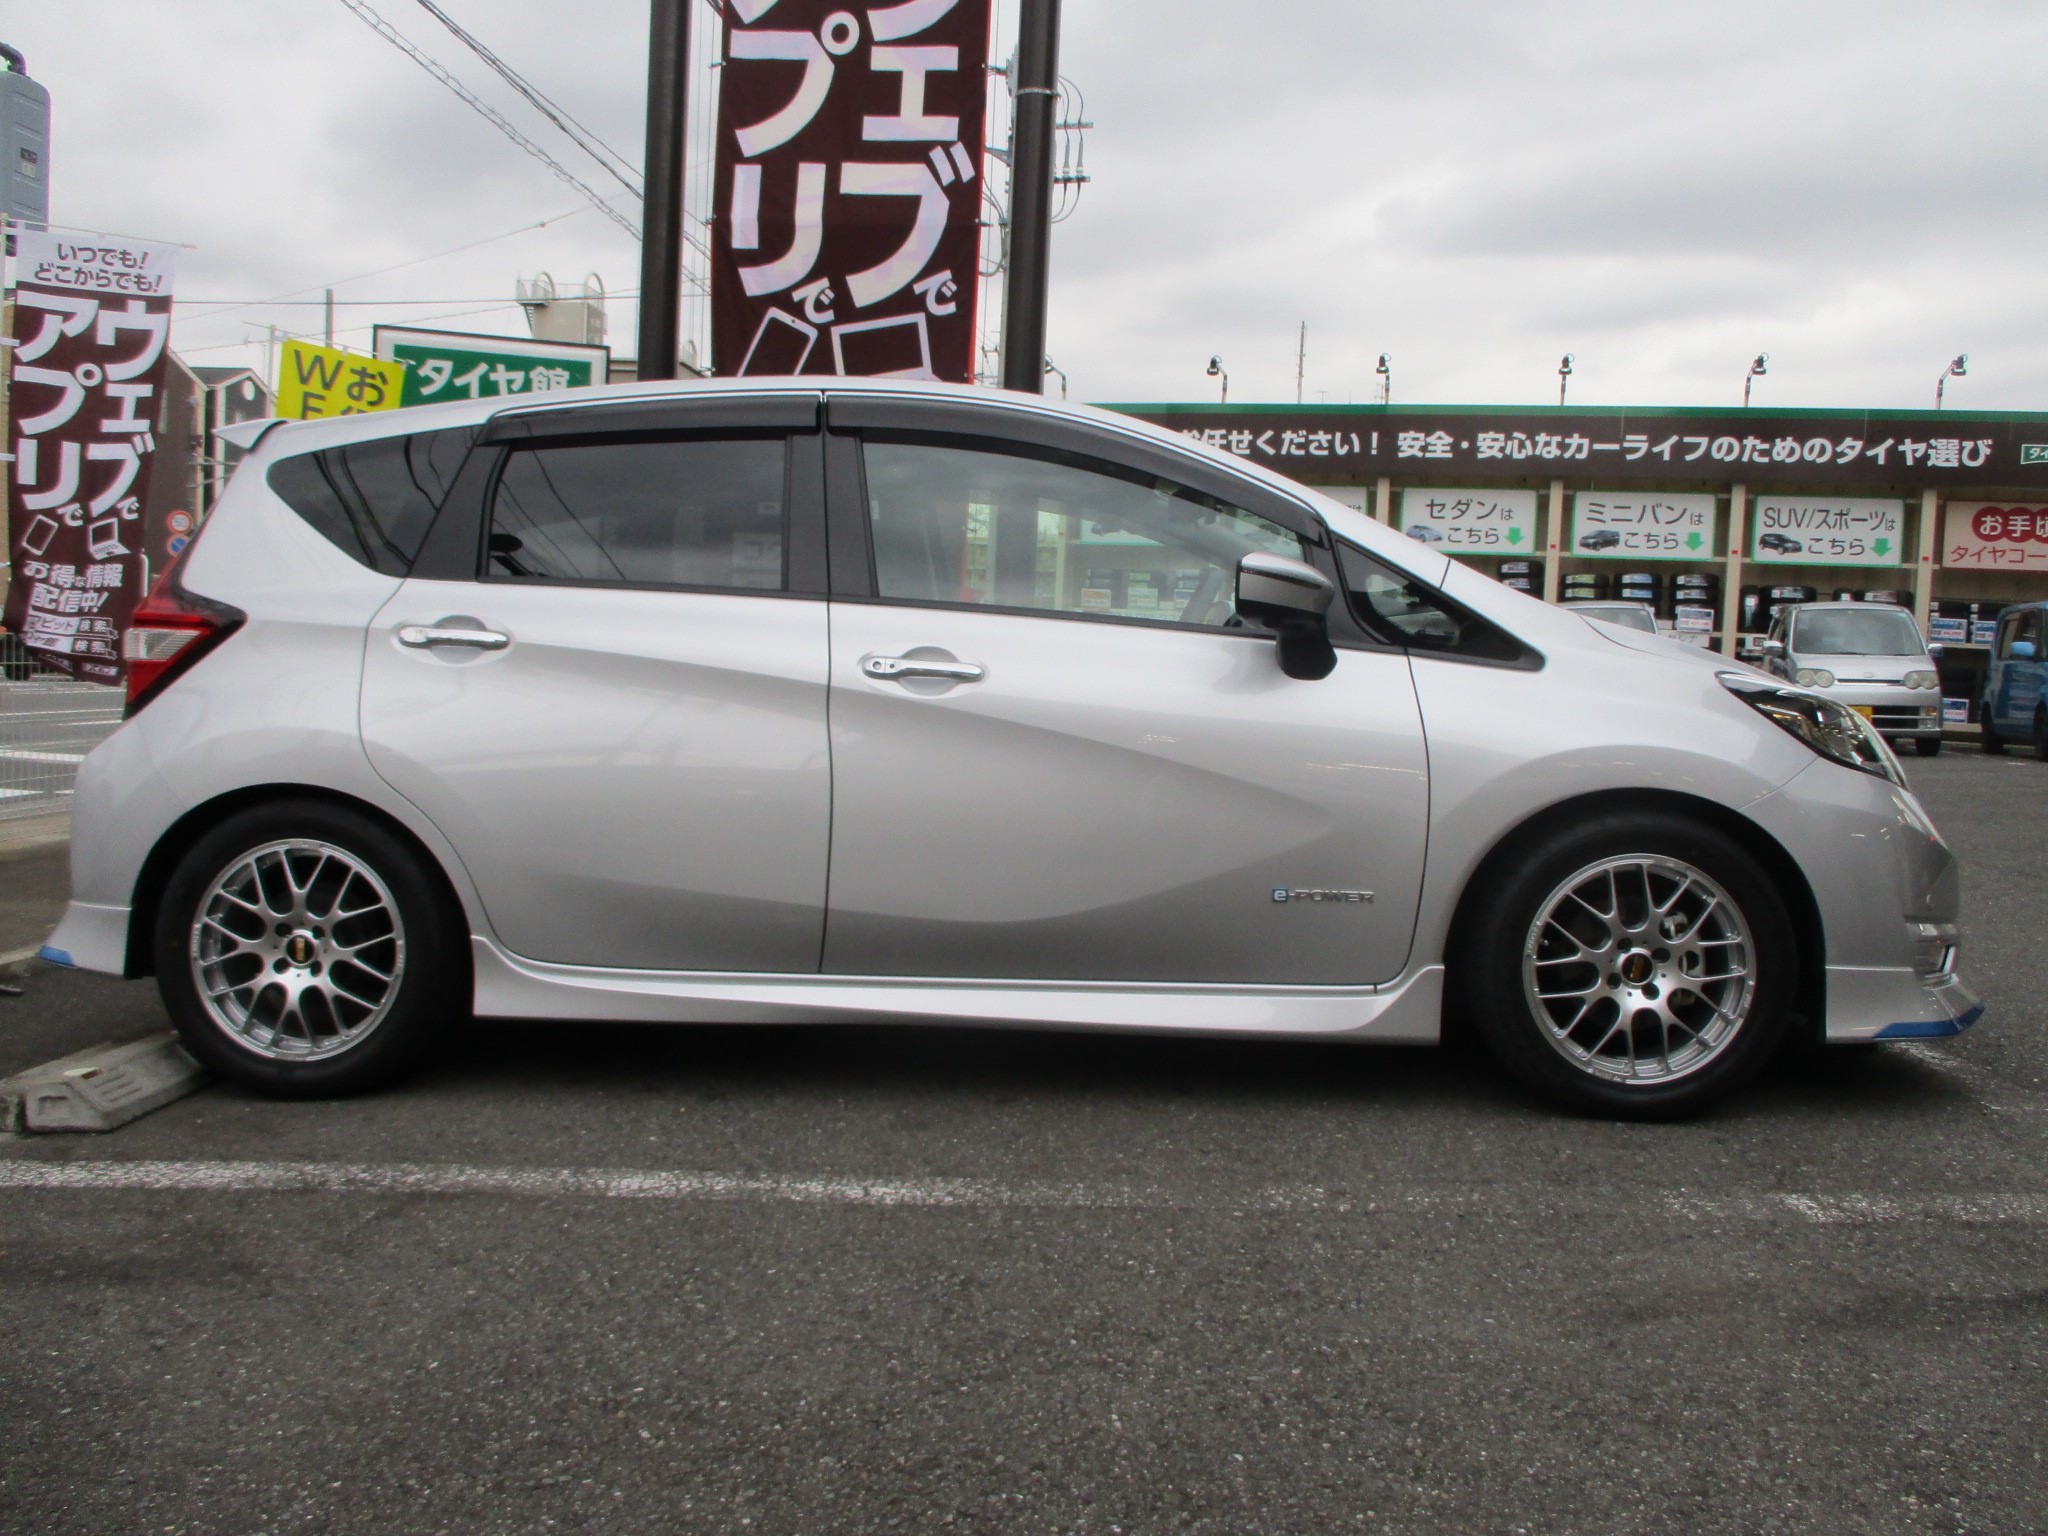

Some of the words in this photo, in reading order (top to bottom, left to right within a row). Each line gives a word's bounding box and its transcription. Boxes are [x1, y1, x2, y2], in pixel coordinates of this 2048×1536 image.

[729, 0, 860, 324] プリで
[57, 243, 149, 270] いつでも!
[34, 262, 163, 293] どこからでも!
[1397, 430, 1993, 468] 安全・安心なカーライフのためのタイヤ選び
[1425, 498, 1514, 521] セダンは
[1585, 501, 1704, 527] ミニバンは
[1763, 506, 1896, 532] SUV/スポーツは
[1447, 525, 1500, 545] こちら
[1623, 531, 1680, 550] こちら
[1807, 537, 1865, 556] こちら
